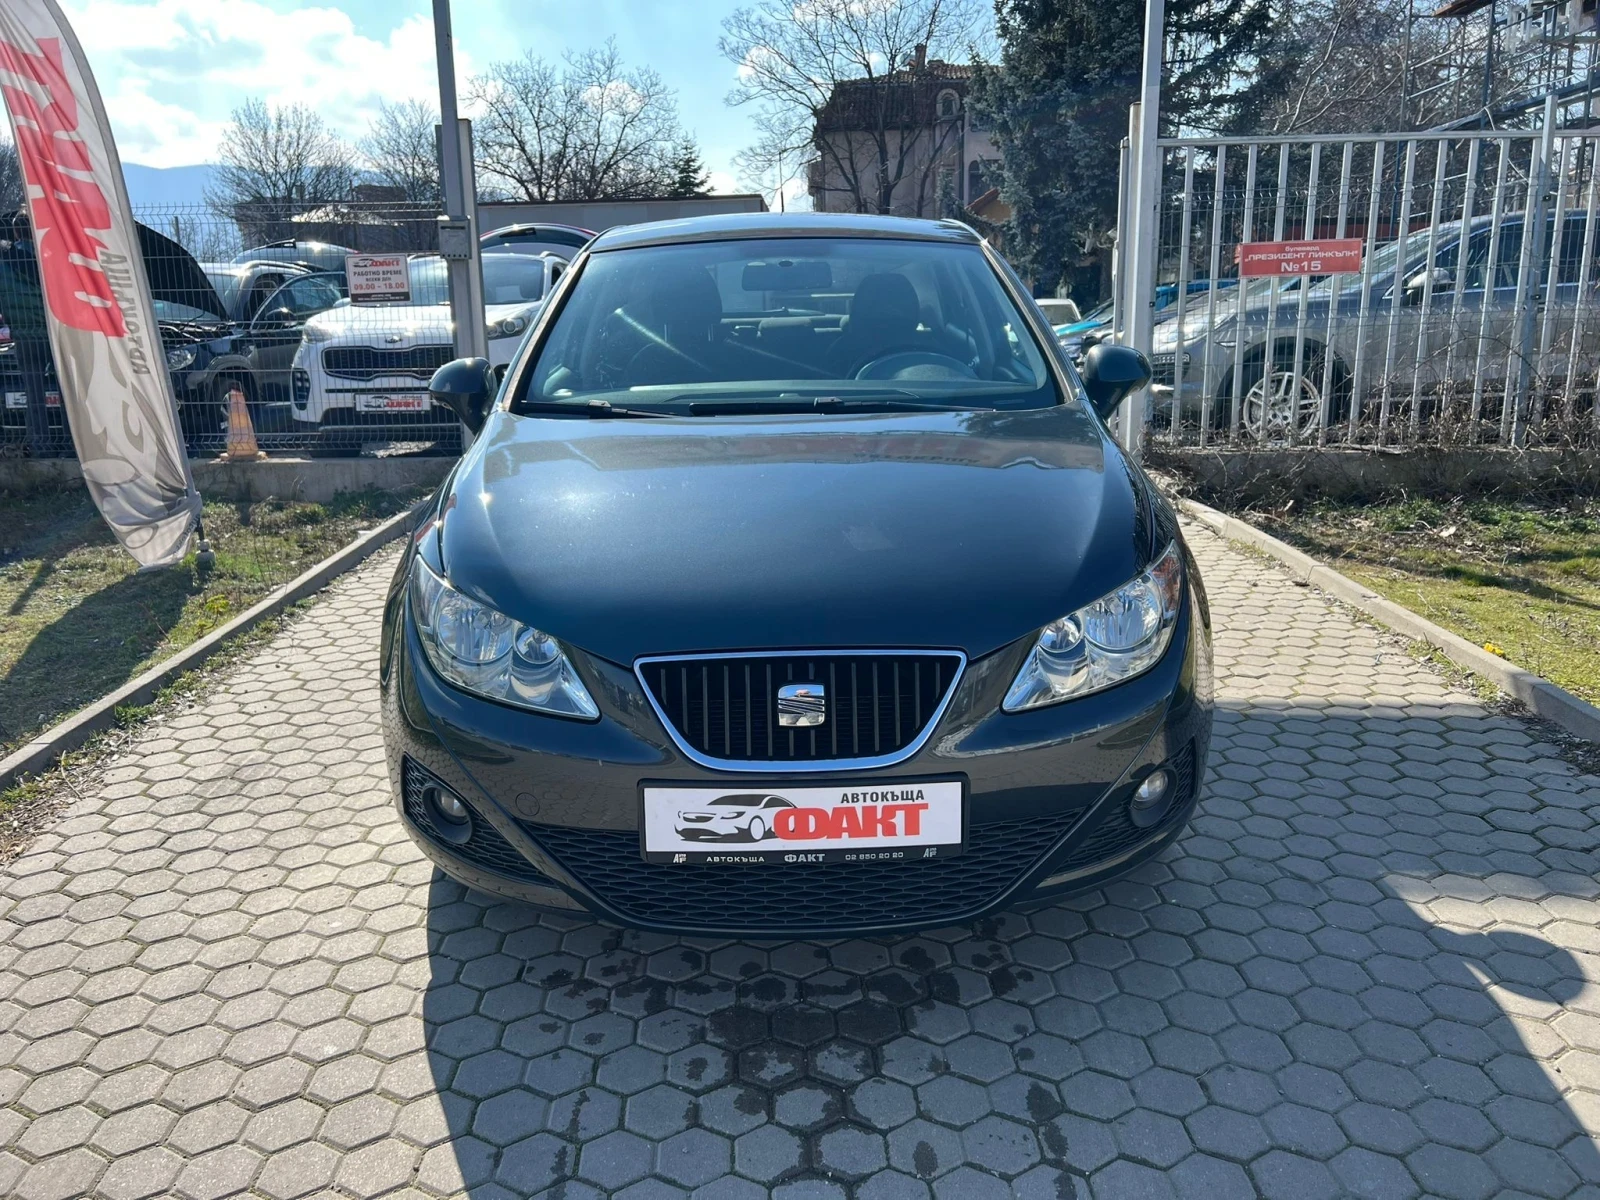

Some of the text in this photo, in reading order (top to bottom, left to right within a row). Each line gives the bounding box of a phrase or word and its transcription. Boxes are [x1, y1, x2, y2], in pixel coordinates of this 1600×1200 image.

[354, 283, 376, 291] 09.00
[841, 789, 925, 803] АВТОКЪЩА
[774, 803, 929, 840] ФАКТ
[784, 853, 825, 863] ФАКТ
